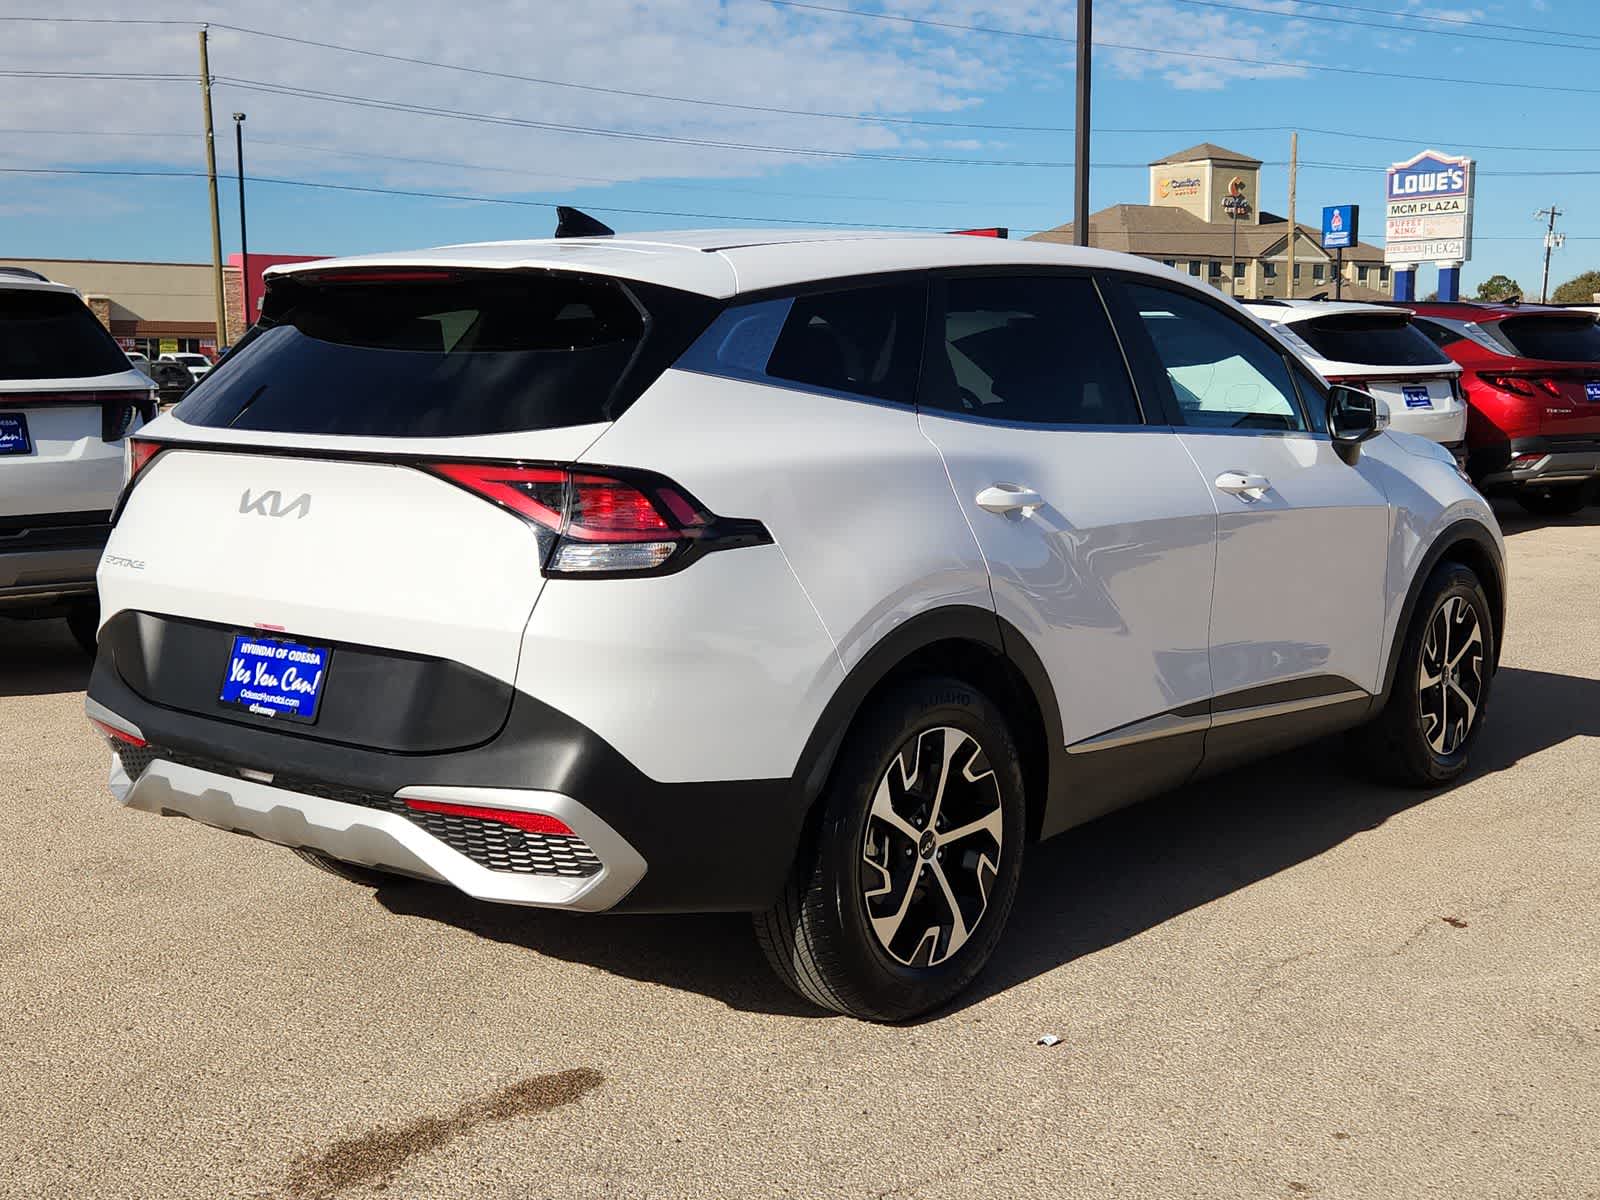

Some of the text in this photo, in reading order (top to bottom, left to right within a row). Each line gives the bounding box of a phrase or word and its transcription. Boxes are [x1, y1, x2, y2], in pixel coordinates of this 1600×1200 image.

[1392, 168, 1464, 195] LOWE'S
[1391, 200, 1459, 215] MCM PLAZA
[1394, 226, 1417, 235] KING
[239, 488, 312, 520] KIA
[240, 642, 321, 665] HYUNDAI OF ODESSA
[230, 658, 322, 695] Yes You Can!
